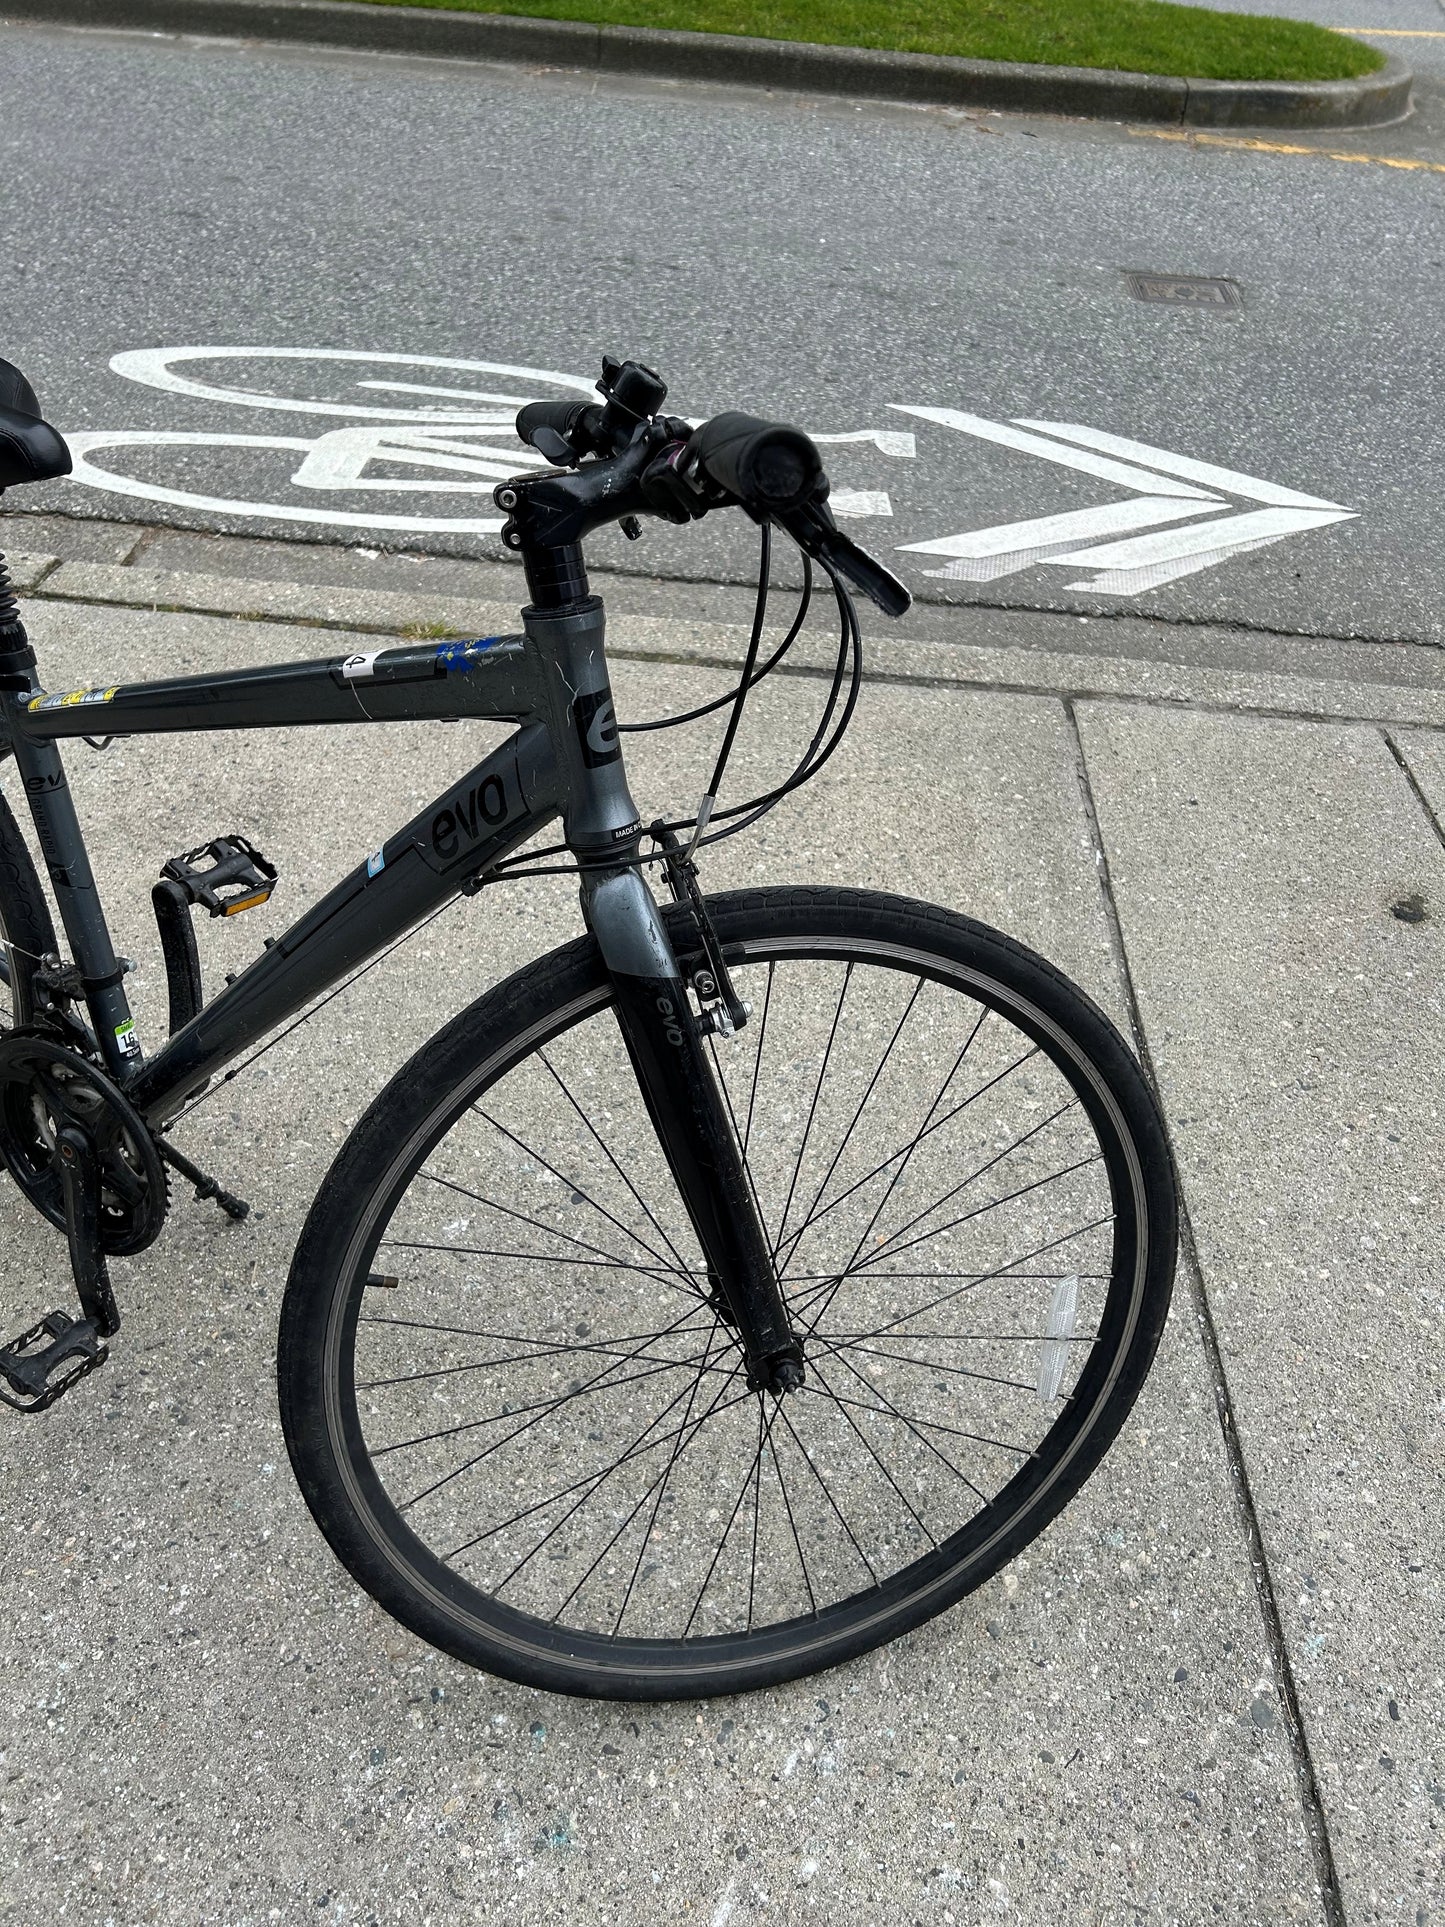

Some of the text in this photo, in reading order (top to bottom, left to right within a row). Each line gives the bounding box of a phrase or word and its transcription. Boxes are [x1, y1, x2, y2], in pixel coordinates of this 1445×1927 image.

[26, 771, 62, 790] ev
[32, 799, 47, 827] GRAND
[41, 829, 56, 854] RAPID
[431, 773, 508, 861] evo
[615, 826, 634, 838] MADE
[656, 997, 683, 1047] evo
[121, 1031, 135, 1048] 16
